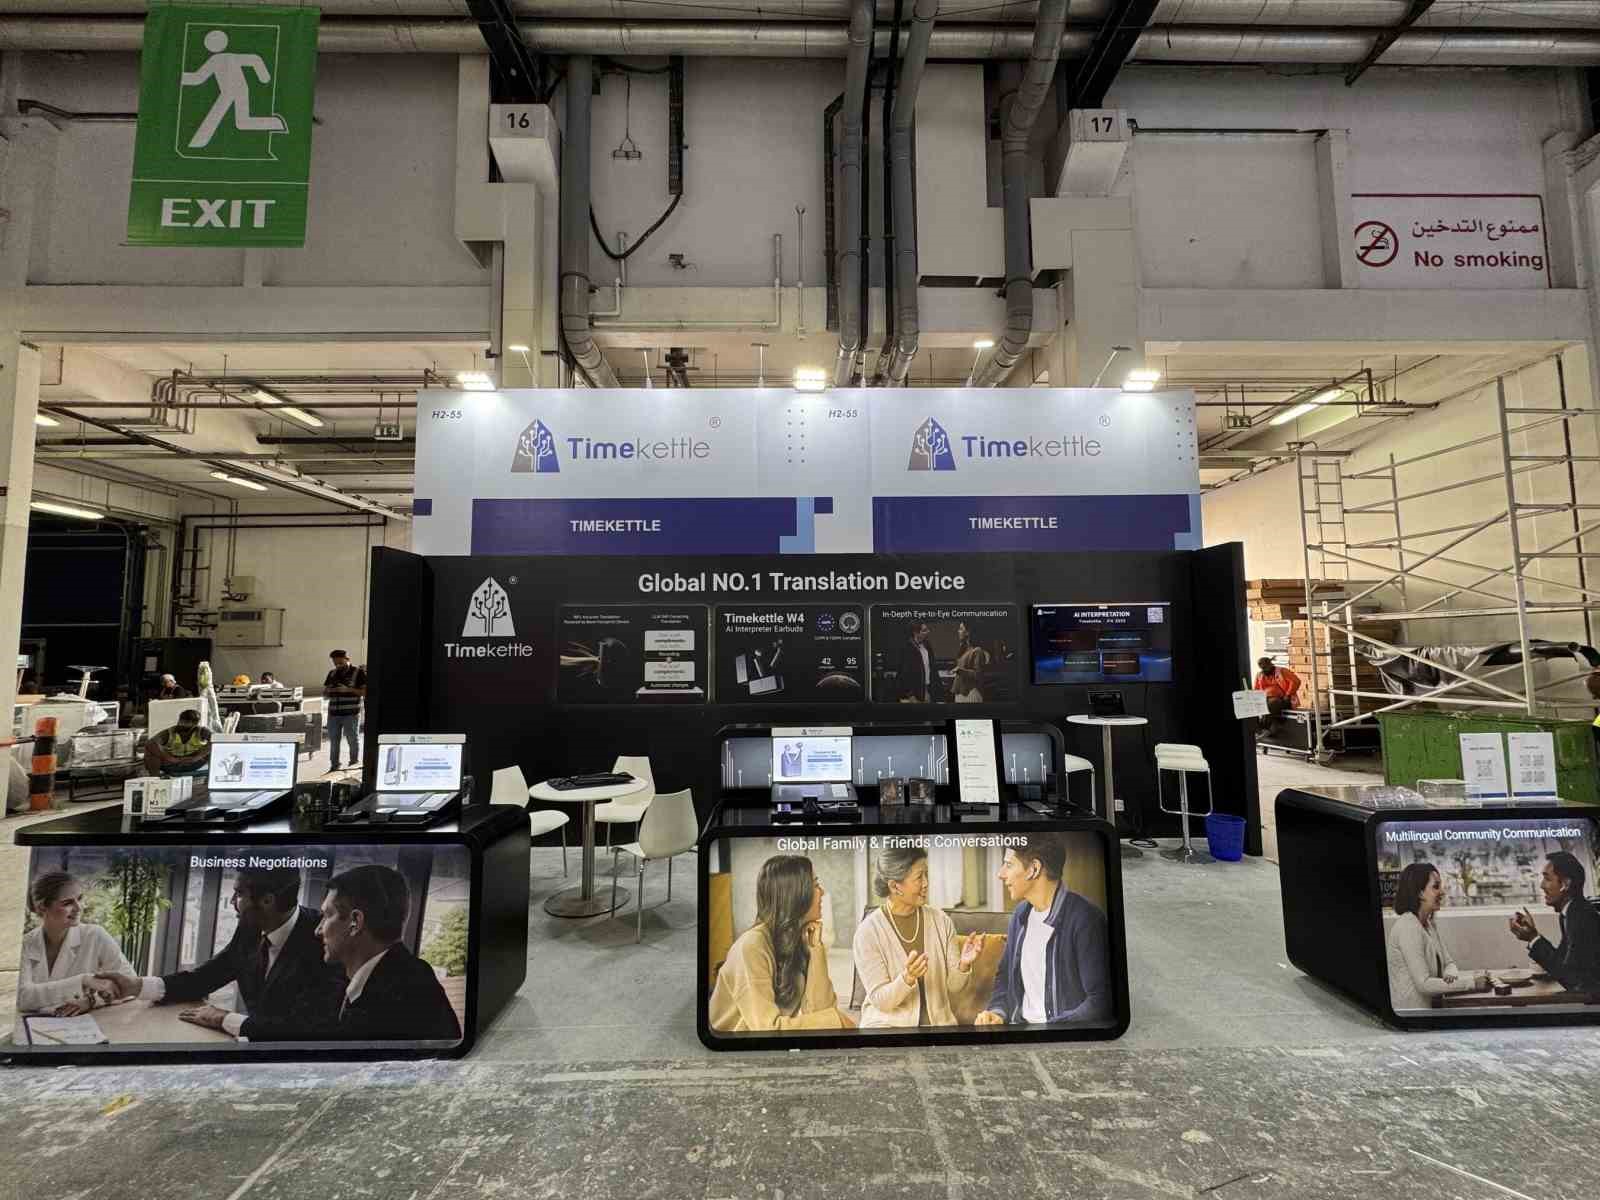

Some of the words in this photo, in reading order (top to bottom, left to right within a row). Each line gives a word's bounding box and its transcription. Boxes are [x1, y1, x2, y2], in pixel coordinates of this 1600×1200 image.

[506, 111, 530, 129] 16
[1091, 117, 1113, 133] 17
[160, 198, 276, 229] EXIT
[1411, 219, 1483, 238] التدخين
[1486, 220, 1539, 241] ممنوع
[1414, 250, 1444, 268] No
[1454, 250, 1544, 271] smoking
[431, 409, 463, 420] H2-55
[828, 408, 858, 419] H2-55
[567, 437, 711, 460] Timekettle
[961, 435, 1101, 459] Timekettle
[570, 519, 662, 533] TIMEKETTLE
[968, 516, 1059, 530] TIMEKETTLE
[638, 573, 706, 592] Global
[712, 573, 761, 591] NO.1
[769, 571, 889, 591] Translation
[895, 571, 966, 590] Device
[724, 612, 784, 624] Timekettle
[786, 612, 805, 624] W4
[882, 610, 912, 619] In-Depth
[951, 609, 1008, 618] Communication
[735, 625, 772, 635] Interpreter
[774, 624, 804, 634] Earbuds
[444, 642, 534, 658] Timekettle
[846, 657, 857, 665] 95
[1385, 829, 1442, 843] Multilingual
[1444, 828, 1501, 842] Community
[1503, 827, 1581, 840] Communication
[777, 838, 821, 852] Global
[823, 837, 866, 852] Family
[869, 837, 879, 849] &
[882, 836, 930, 849] Friends
[934, 835, 1028, 848] Conversations
[190, 856, 246, 868] Business
[249, 856, 328, 871] Negotiations
